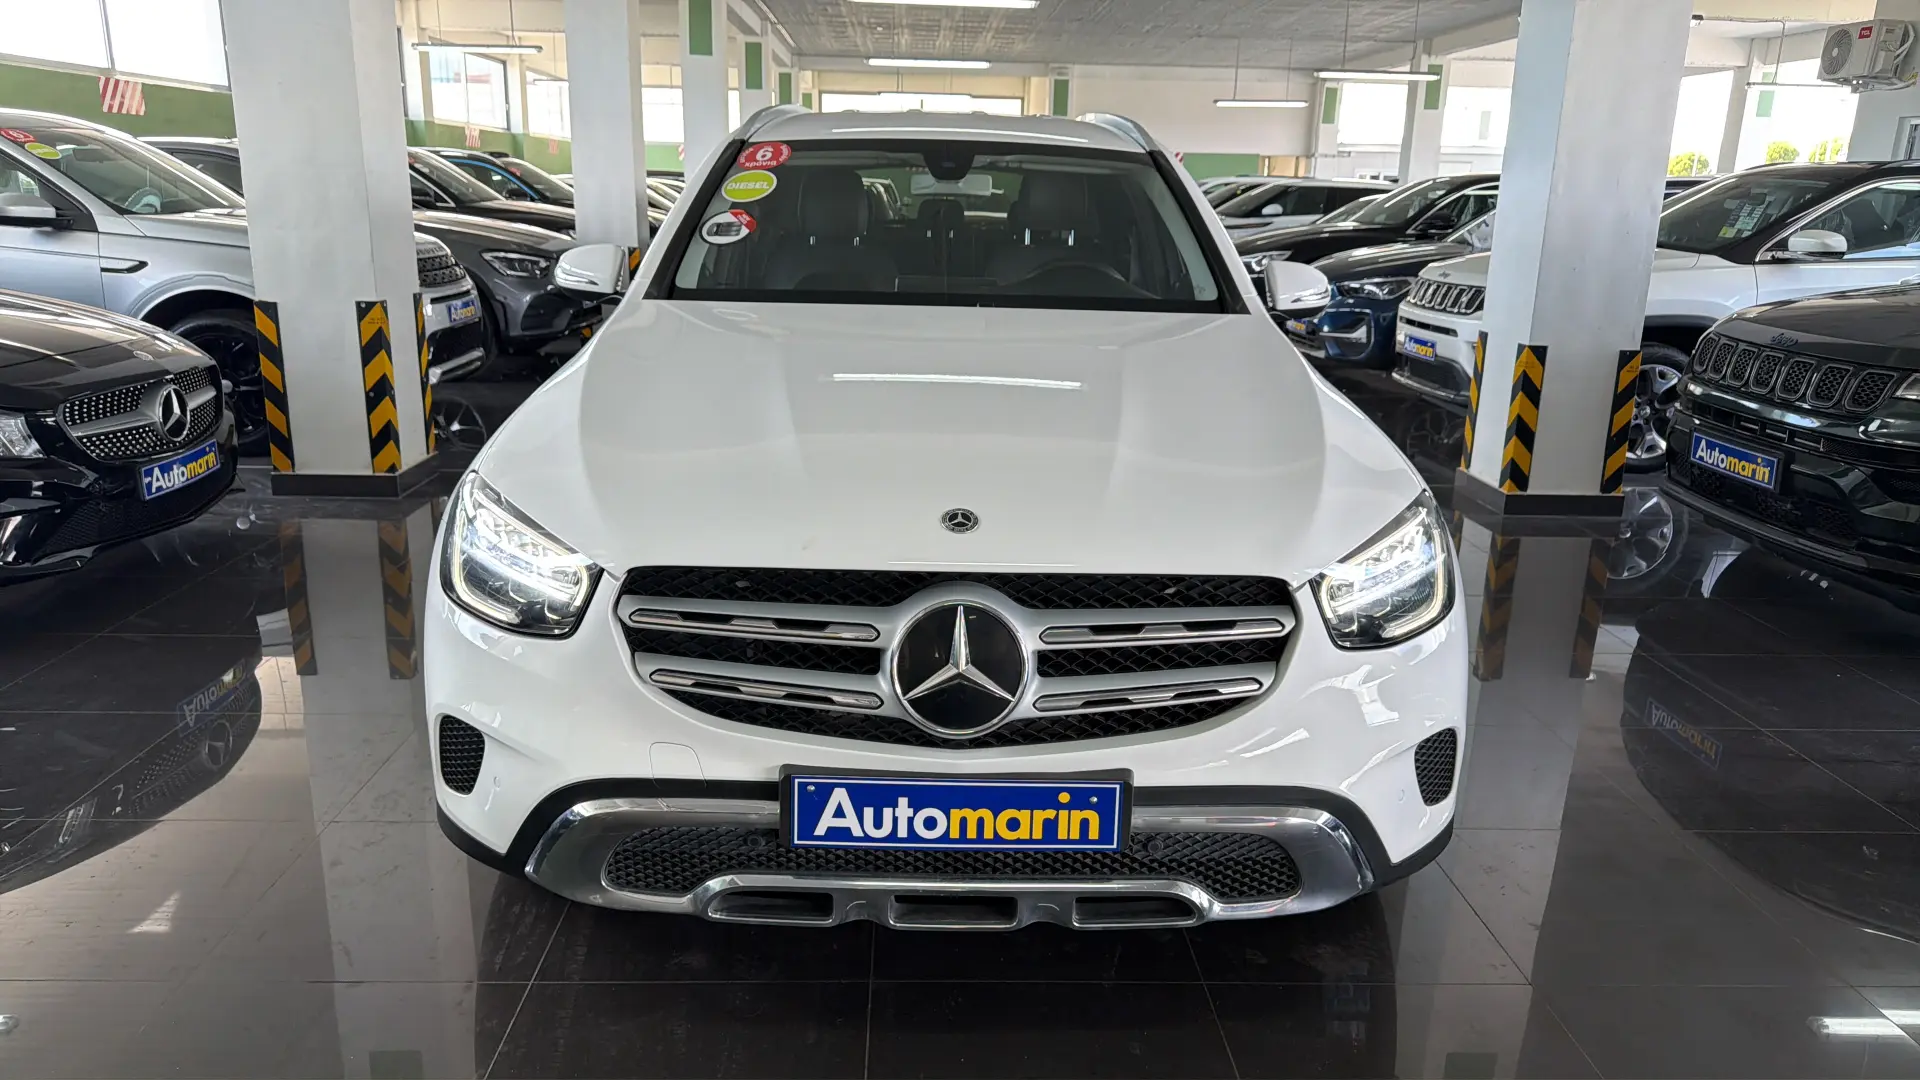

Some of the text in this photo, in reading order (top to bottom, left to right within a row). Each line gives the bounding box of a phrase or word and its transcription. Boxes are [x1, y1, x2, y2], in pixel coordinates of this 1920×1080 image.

[755, 147, 774, 161] 6
[726, 181, 770, 190] DIESEL
[151, 446, 217, 493] Automarin
[1696, 439, 1770, 483] Automarin
[813, 787, 1099, 841] Automarin
